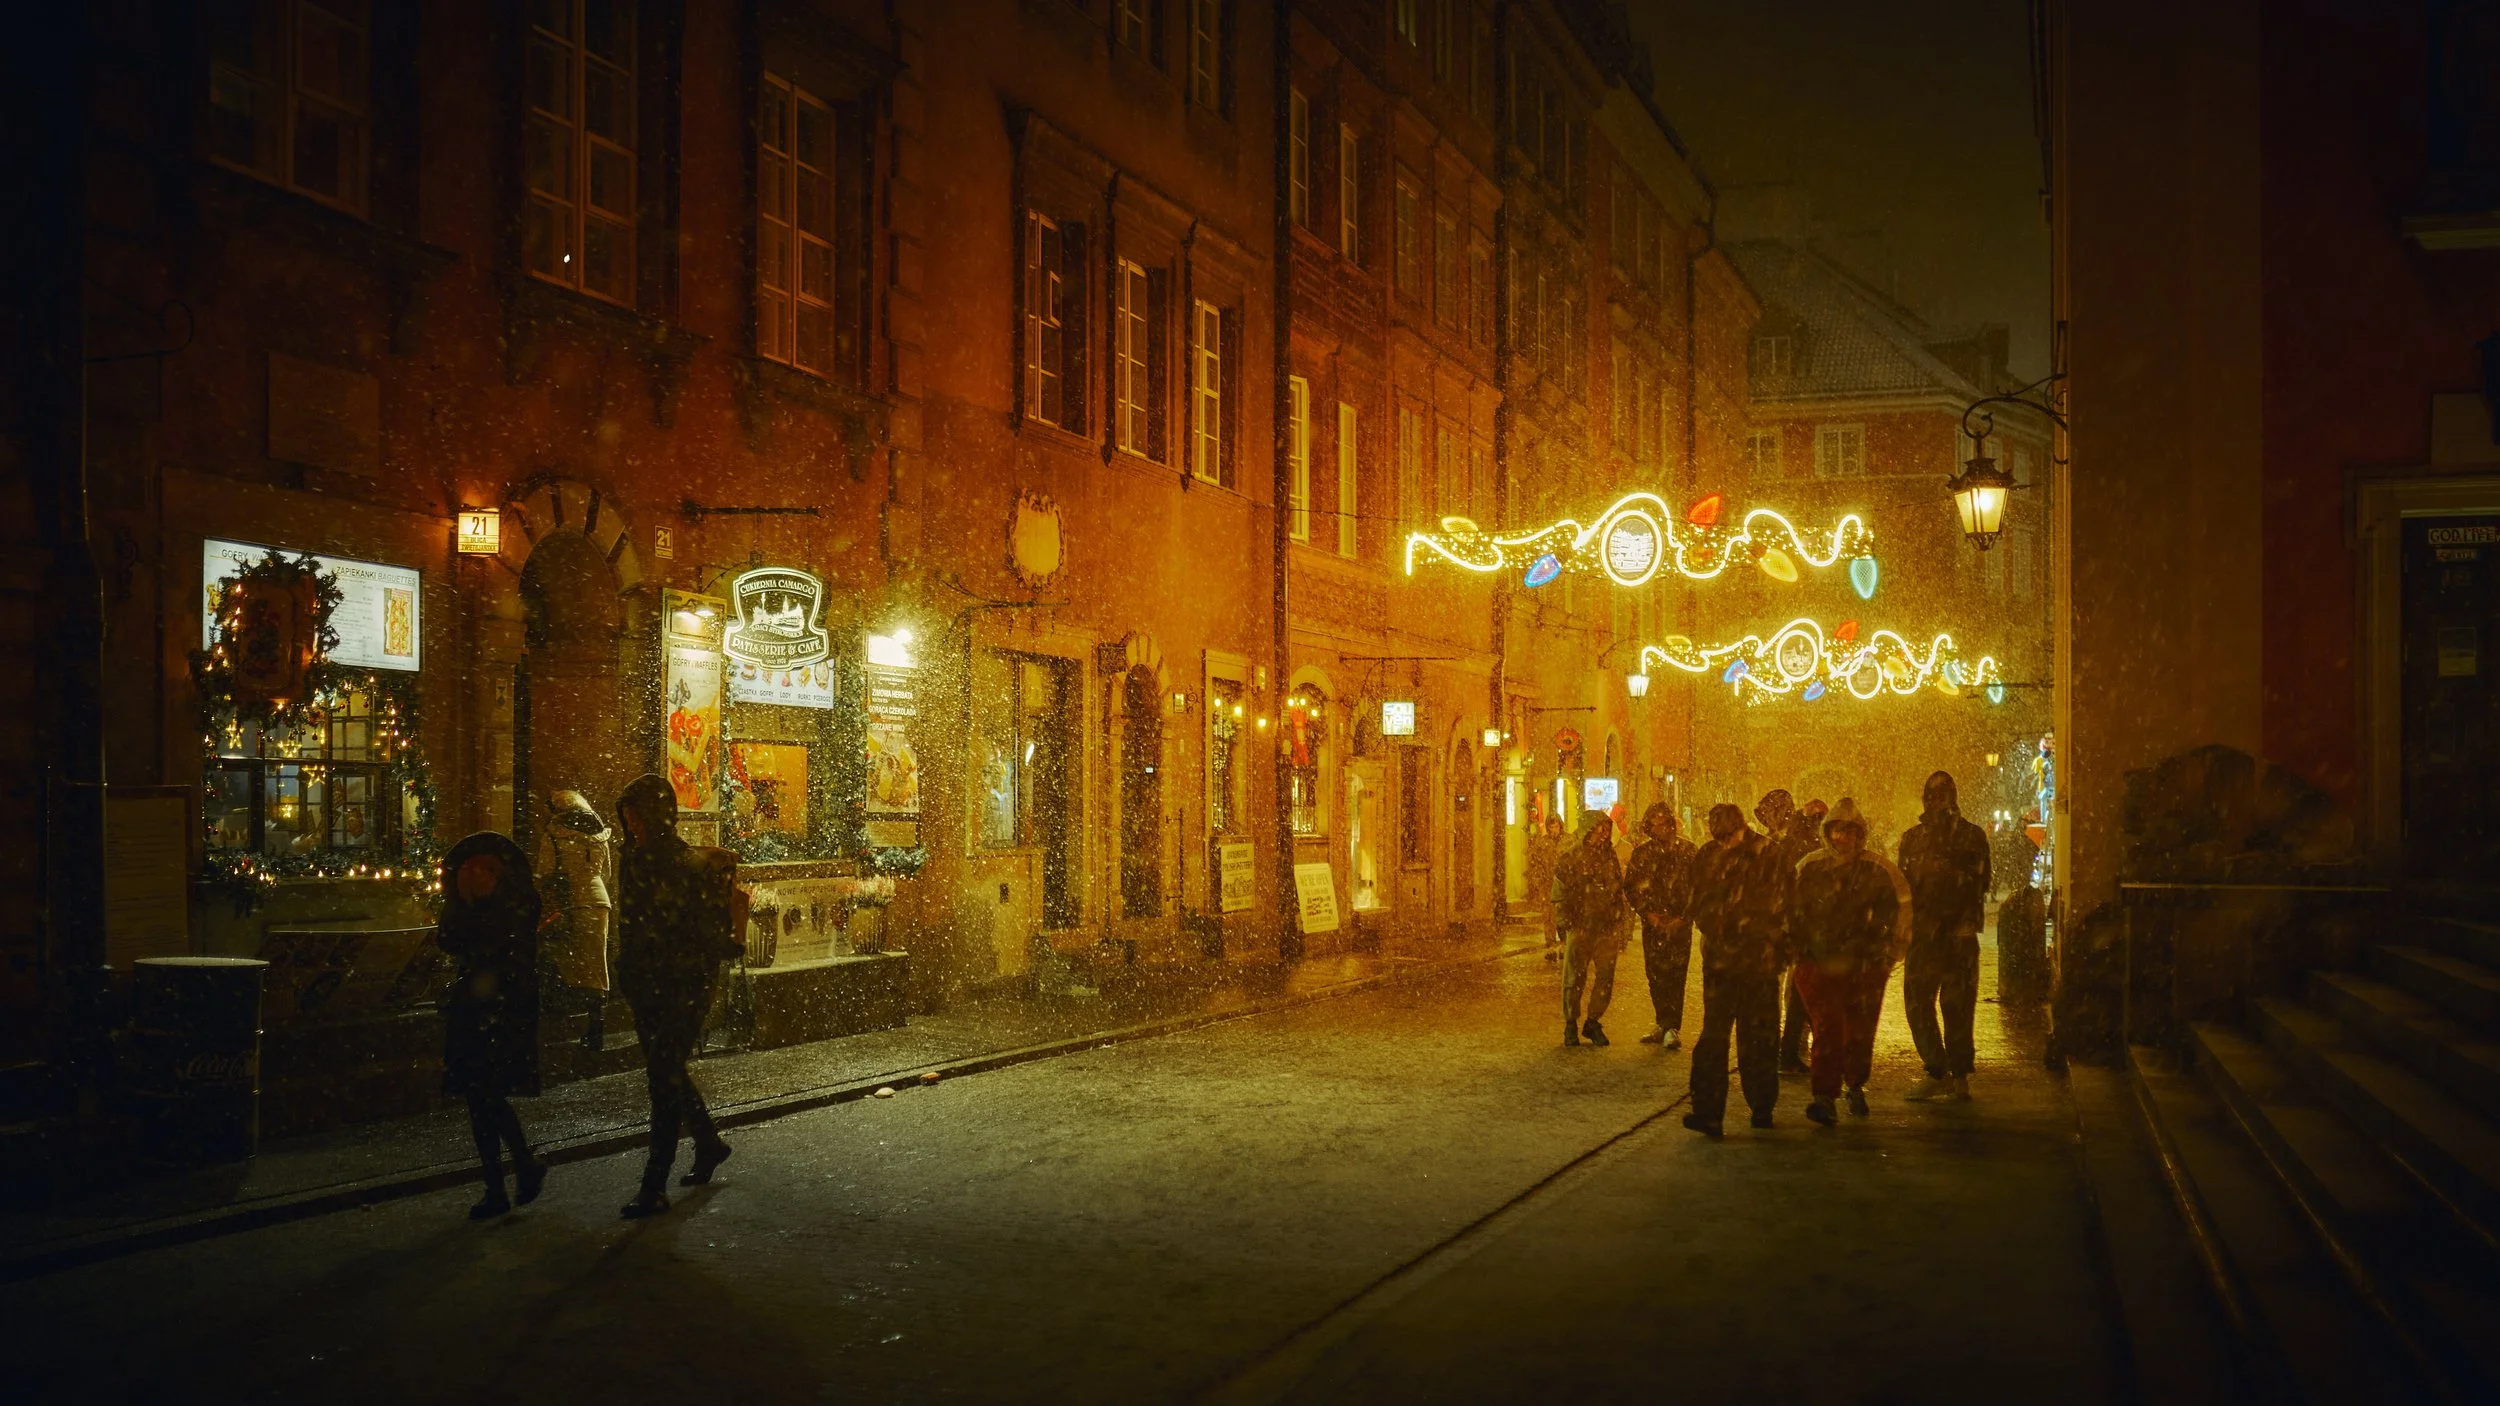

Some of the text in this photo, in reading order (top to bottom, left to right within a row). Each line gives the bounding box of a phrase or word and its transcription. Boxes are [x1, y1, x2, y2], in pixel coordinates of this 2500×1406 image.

[472, 516, 487, 536] 21
[657, 530, 671, 547] 21
[221, 549, 249, 560] GOFRY
[336, 566, 416, 586] ZAPIEKANKI BAGUETTES
[740, 579, 815, 595] CUKIERNIA CAMARGO
[732, 637, 787, 656] PATISSERIE
[787, 644, 796, 655] &
[673, 657, 690, 668] GOFRY
[695, 660, 718, 671] WAFFLES
[892, 690, 913, 699] HERBATA
[889, 706, 917, 716] CZEKOLADA
[777, 887, 796, 896] NOWE
